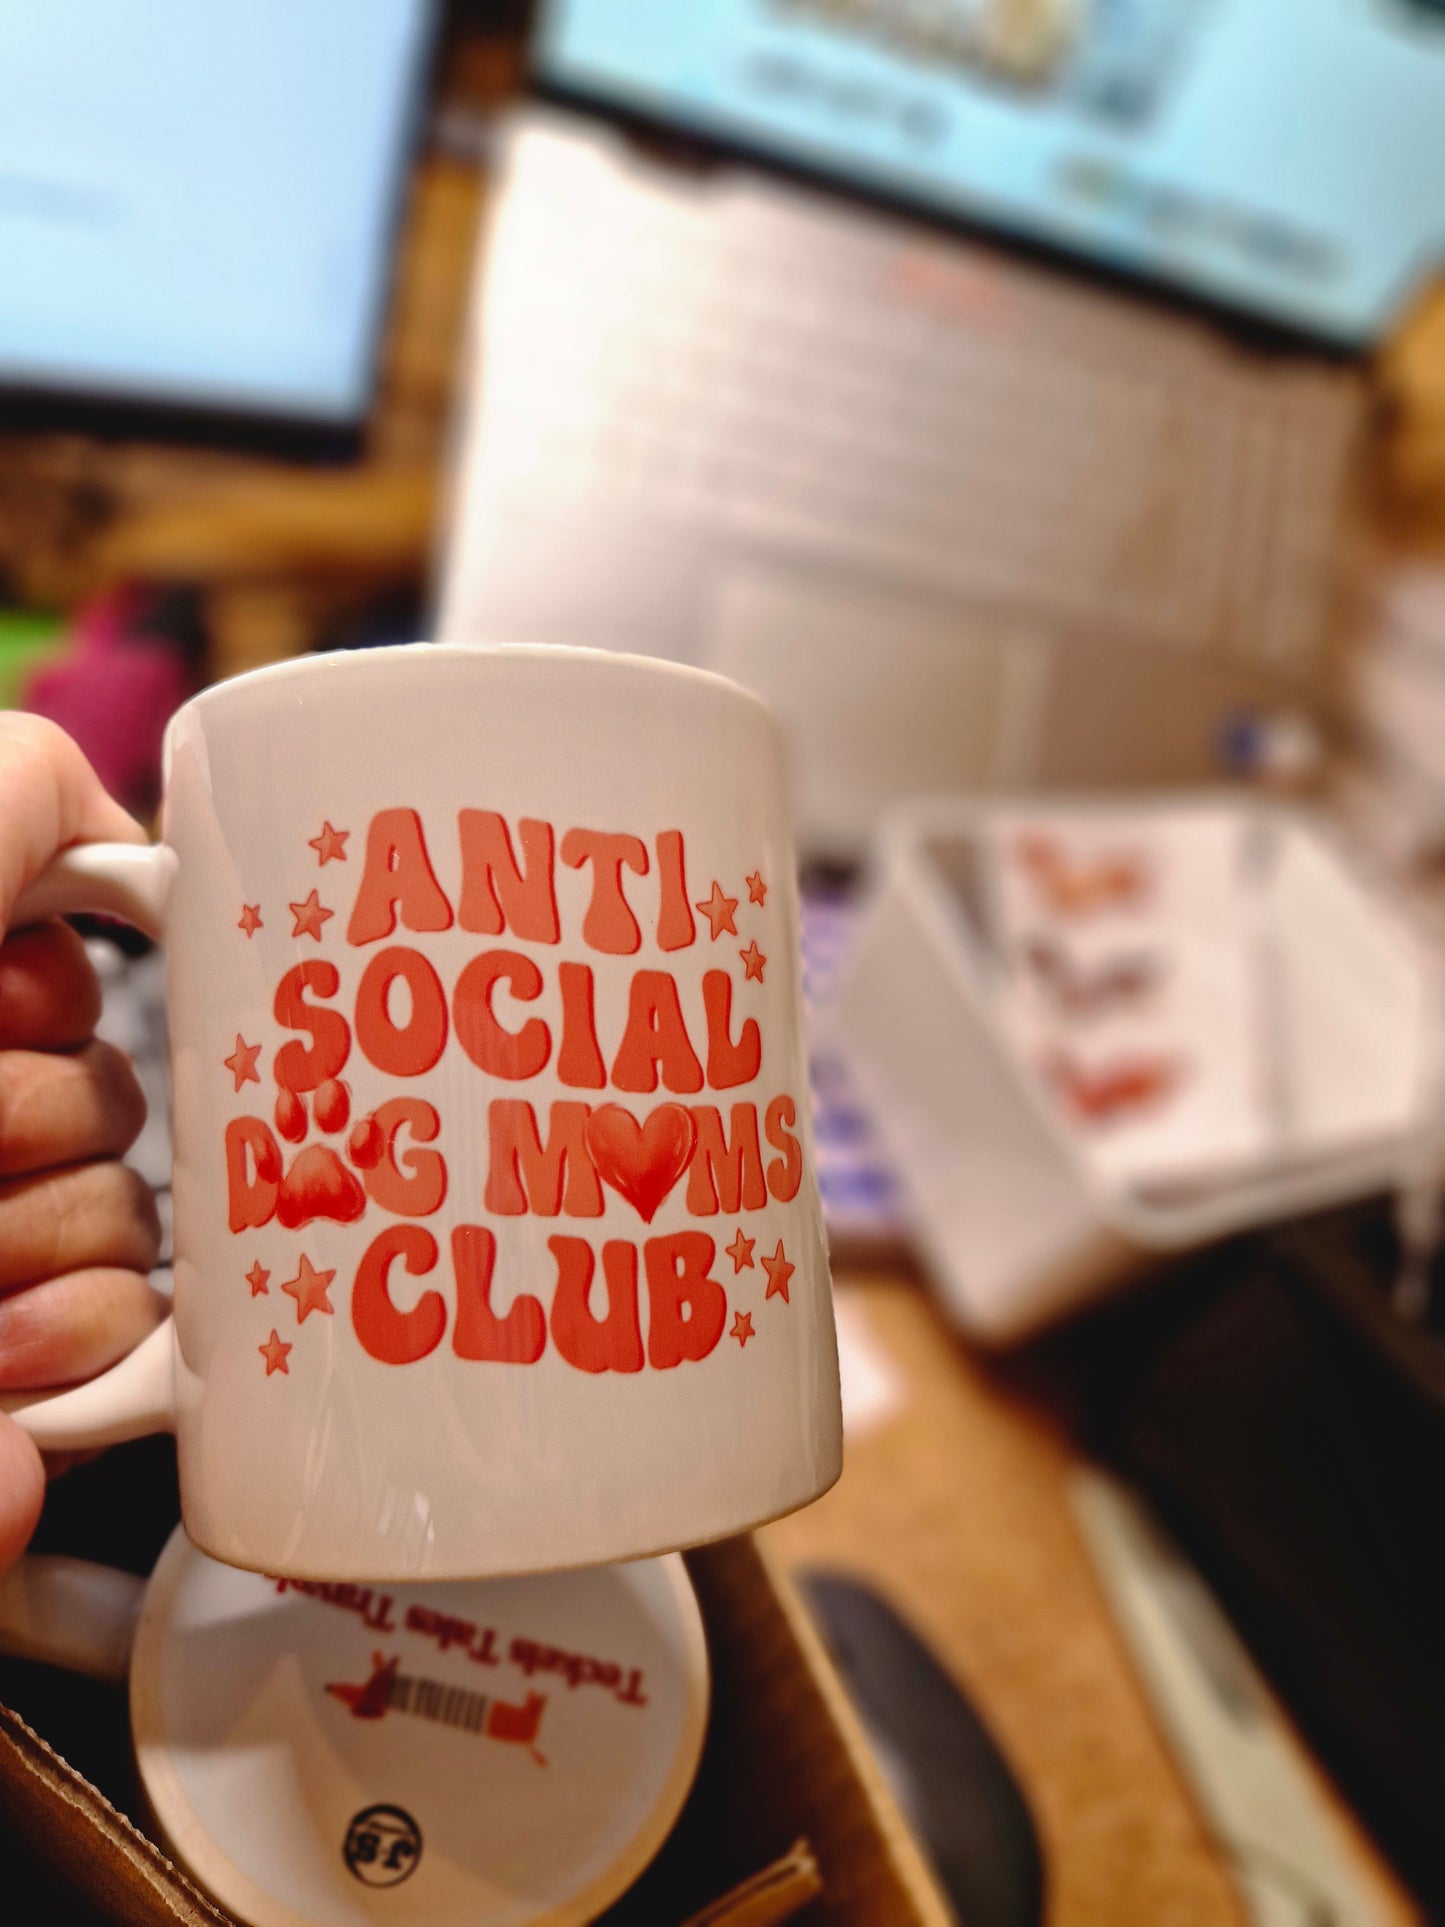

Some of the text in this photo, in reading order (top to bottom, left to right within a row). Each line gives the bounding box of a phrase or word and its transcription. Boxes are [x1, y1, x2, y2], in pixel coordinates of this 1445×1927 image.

[346, 808, 696, 955] ANTI
[273, 946, 762, 1093] SOCIAL
[225, 1085, 802, 1235] DG MMS
[351, 1223, 727, 1374] CLUB
